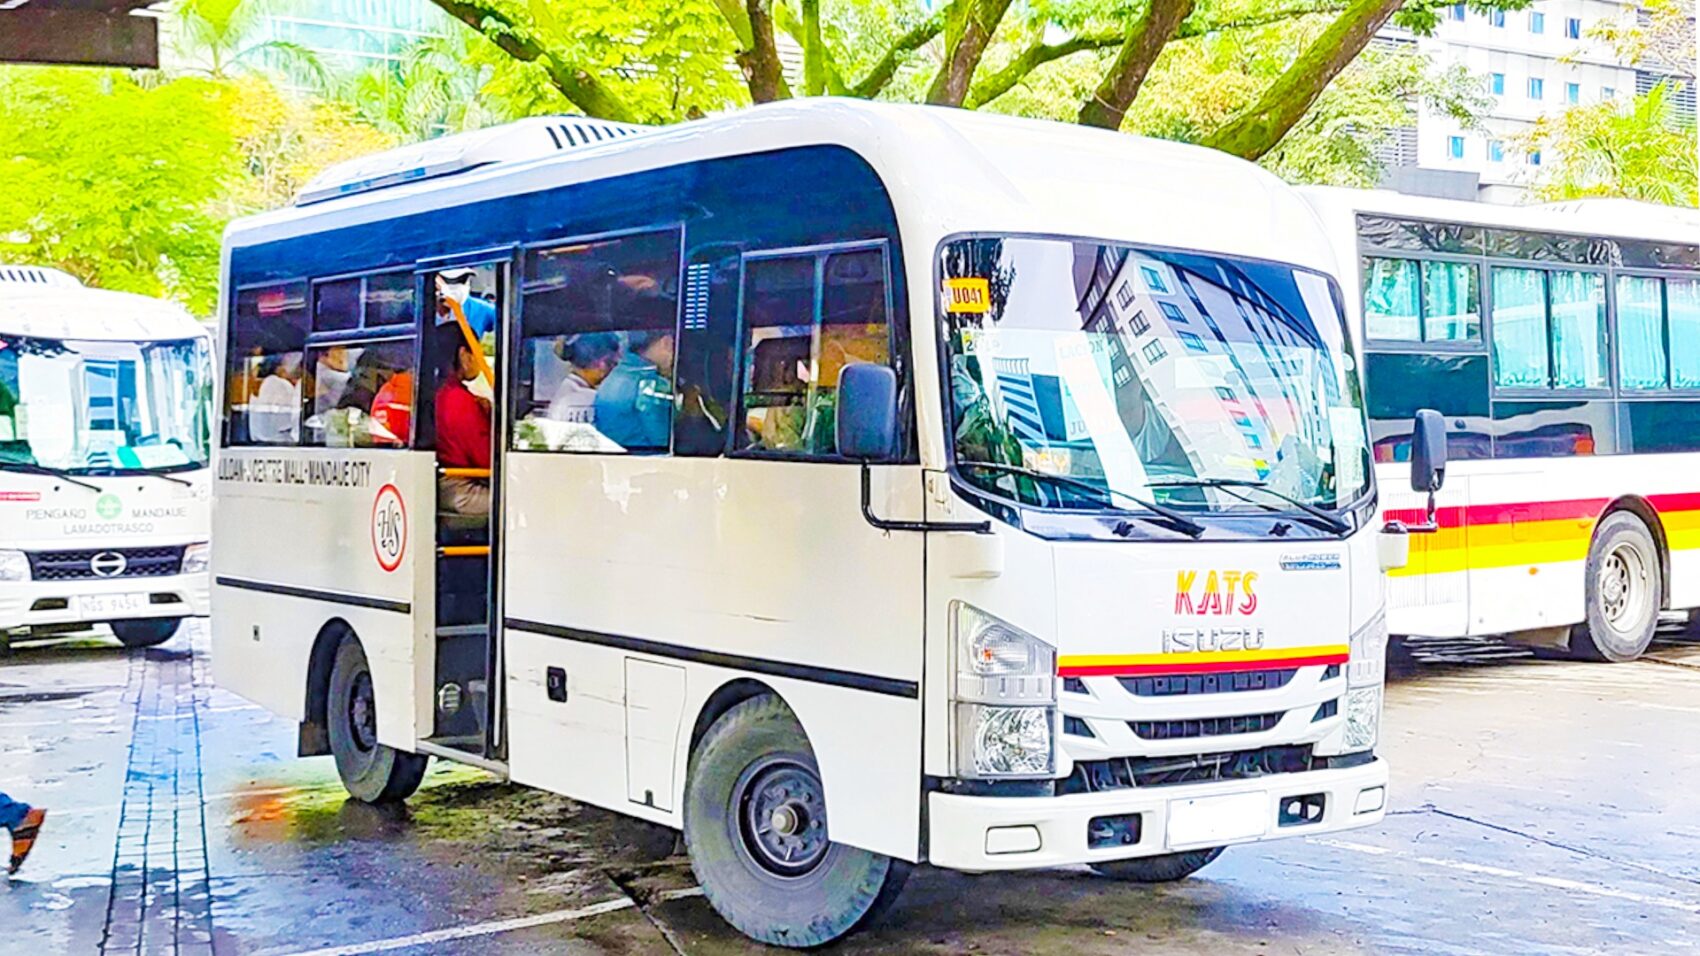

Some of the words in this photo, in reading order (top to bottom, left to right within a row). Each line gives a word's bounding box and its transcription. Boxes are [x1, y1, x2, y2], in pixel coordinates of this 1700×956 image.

[953, 286, 983, 304] U041
[351, 461, 372, 488] CITY
[1174, 569, 1260, 616] KATS
[1162, 627, 1265, 655] ISUZU
